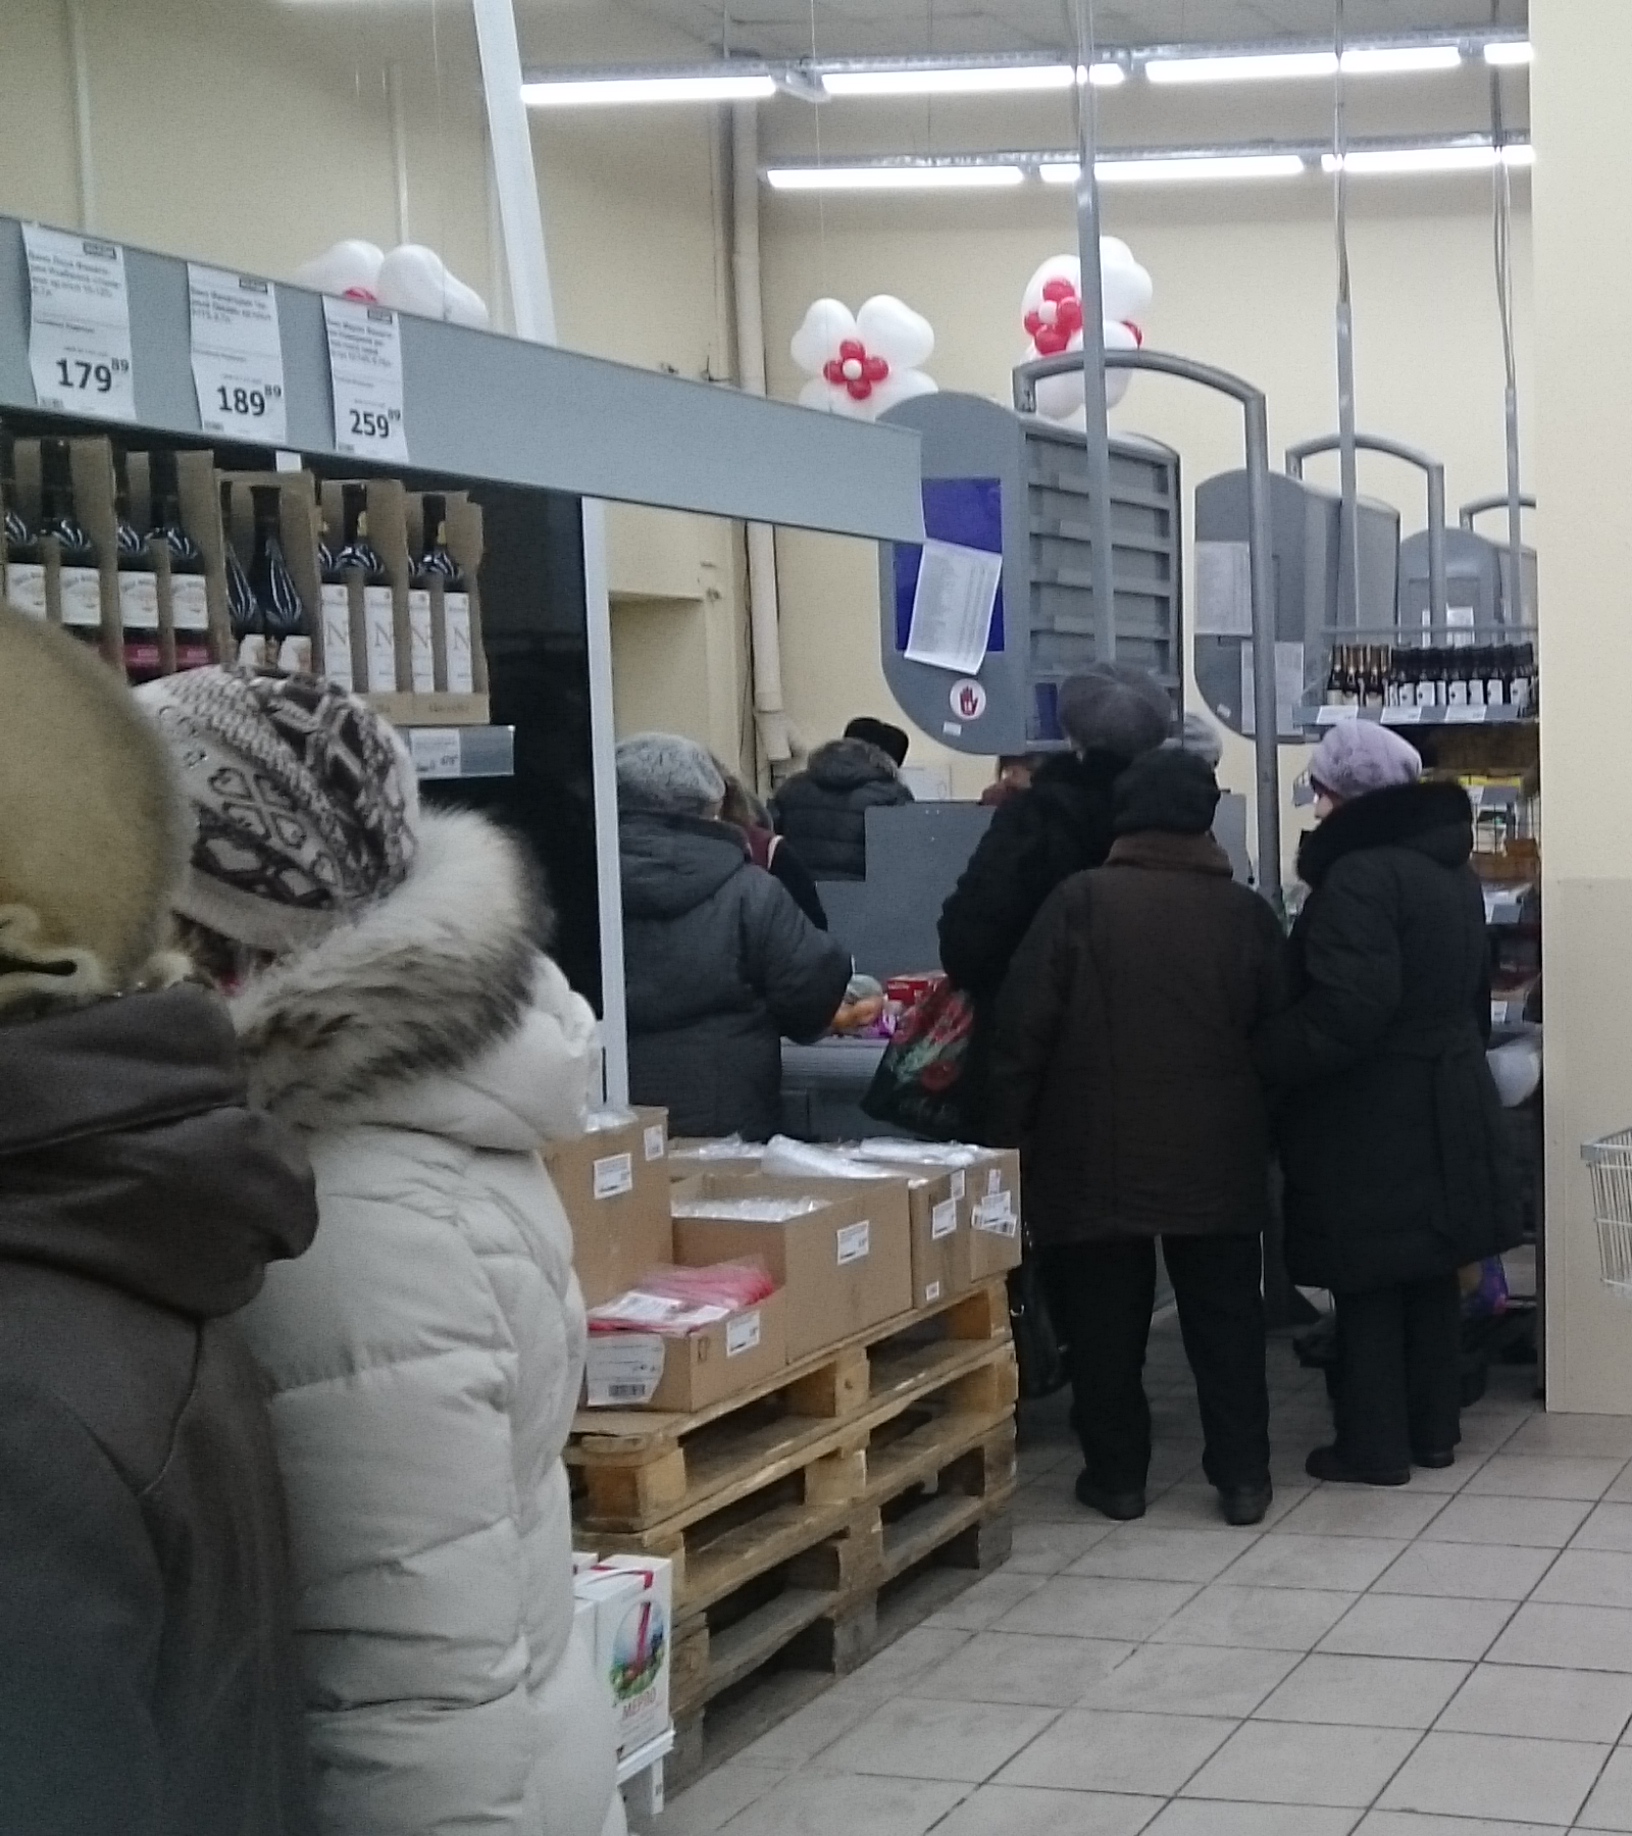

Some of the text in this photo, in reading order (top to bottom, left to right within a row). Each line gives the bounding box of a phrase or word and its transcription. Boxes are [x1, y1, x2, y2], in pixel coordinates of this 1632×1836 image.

[56, 357, 130, 393] 179 89
[216, 383, 283, 417] 189 89
[349, 408, 390, 439] 259
